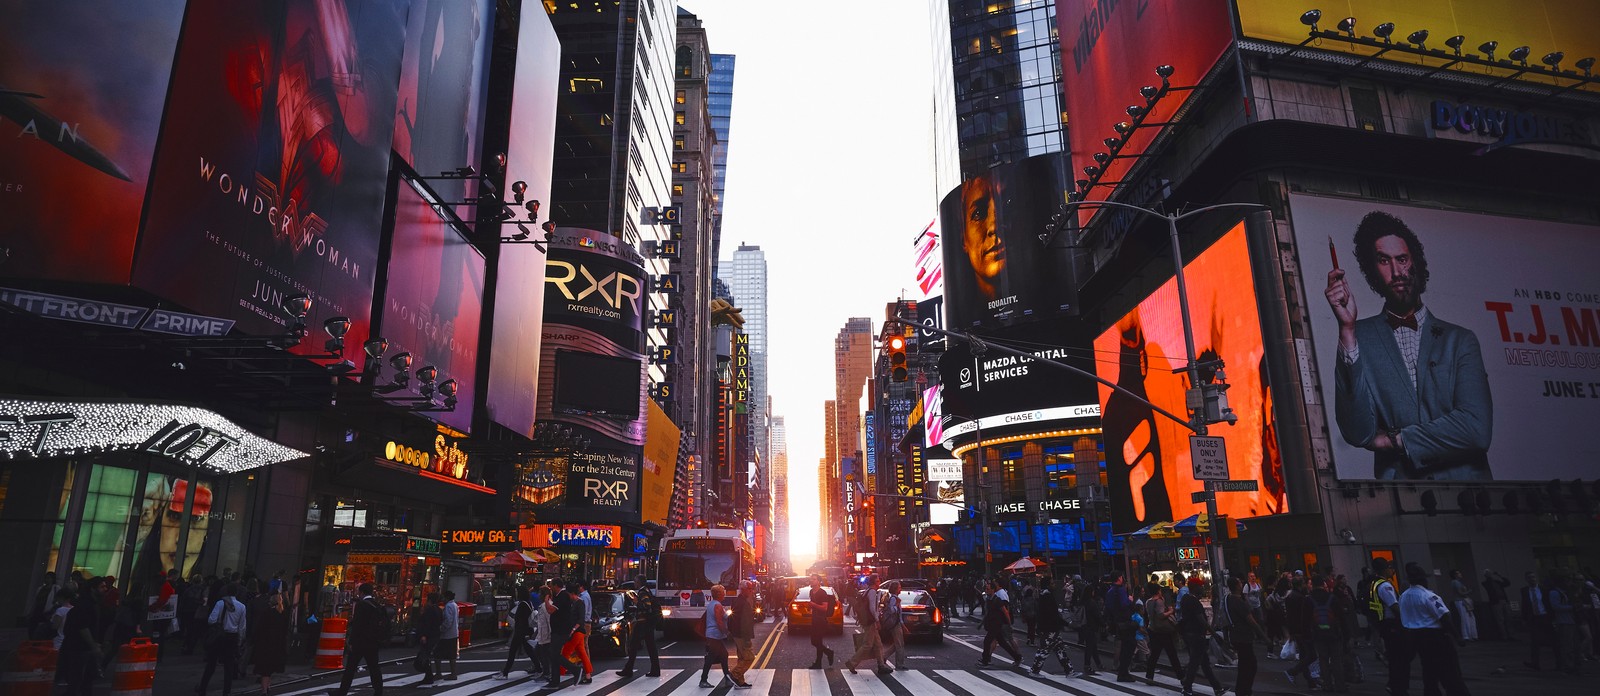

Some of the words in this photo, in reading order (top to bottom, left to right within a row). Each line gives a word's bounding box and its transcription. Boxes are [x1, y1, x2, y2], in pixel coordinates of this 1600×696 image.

[0, 116, 80, 143] AN
[0, 183, 23, 193] ER
[200, 156, 292, 235] WONDER
[303, 228, 360, 280] WOMAN
[205, 231, 220, 245] THE
[223, 241, 250, 262] FUTURE
[254, 258, 263, 268] OF
[266, 266, 291, 285] JUSTICE
[294, 281, 315, 299] BEGINS
[252, 280, 288, 308] JUN
[546, 260, 640, 317] RXR
[1514, 288, 1529, 298] AN
[1535, 290, 1560, 300] HBO
[661, 209, 677, 397] CHAMPS
[988, 295, 1019, 309] EQUALITY.
[0, 291, 138, 325] UTFRONT
[154, 314, 226, 335] PRIME
[392, 298, 437, 339] WONDER
[568, 303, 621, 320] rxrrealty.com
[1485, 301, 1560, 345] T.J.
[541, 332, 580, 341] SHARP
[737, 334, 748, 401] MADAME
[983, 356, 1018, 371] MAZDA
[984, 366, 1029, 382] SERVICES
[1543, 380, 1586, 398] JUNE
[1005, 413, 1033, 423] CHASE
[1074, 406, 1101, 415] CHAS
[960, 422, 977, 432] CHASE
[146, 419, 239, 465] LOFT
[607, 453, 623, 464] New
[623, 455, 635, 466] York
[1200, 449, 1216, 457] ONLY
[572, 463, 586, 472] for
[586, 463, 600, 474] the
[600, 465, 614, 475] 21st
[614, 466, 636, 480] Century
[913, 445, 921, 483] VICTORY
[584, 478, 629, 500] RXR
[1224, 481, 1256, 490] Broadway
[846, 482, 854, 533] REGAL
[995, 502, 1026, 514] CHASE
[1040, 499, 1080, 511] CHASE
[911, 521, 931, 529] SKCHERS
[452, 531, 485, 543] KNOW
[488, 530, 516, 543] GAE
[548, 528, 614, 544] CHAMPS
[1179, 548, 1201, 559] SODA
